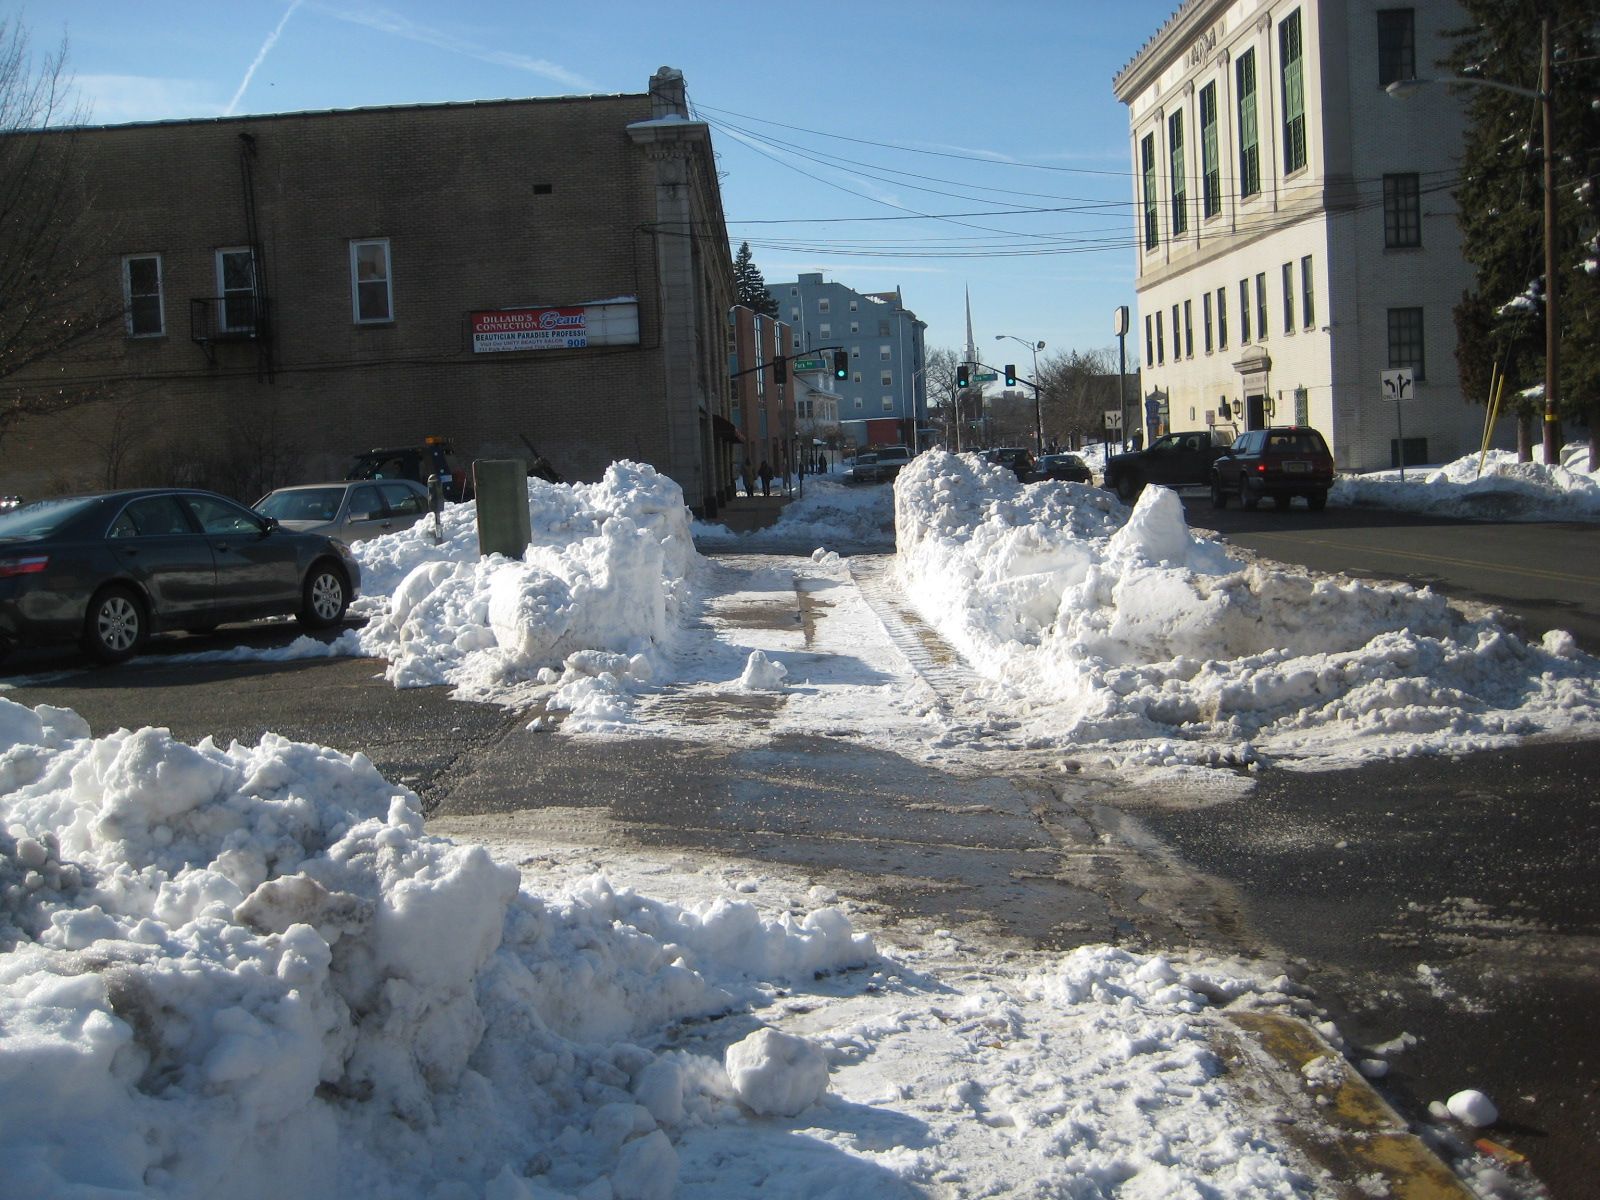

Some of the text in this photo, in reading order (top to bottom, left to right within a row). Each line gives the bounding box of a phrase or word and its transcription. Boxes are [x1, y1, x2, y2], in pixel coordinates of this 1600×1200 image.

[483, 314, 532, 324] DILLARD'S
[476, 321, 537, 331] CONNECTION
[475, 333, 516, 341] BEAUTICIAN
[517, 331, 550, 339] PARADISE
[567, 339, 586, 347] 908
